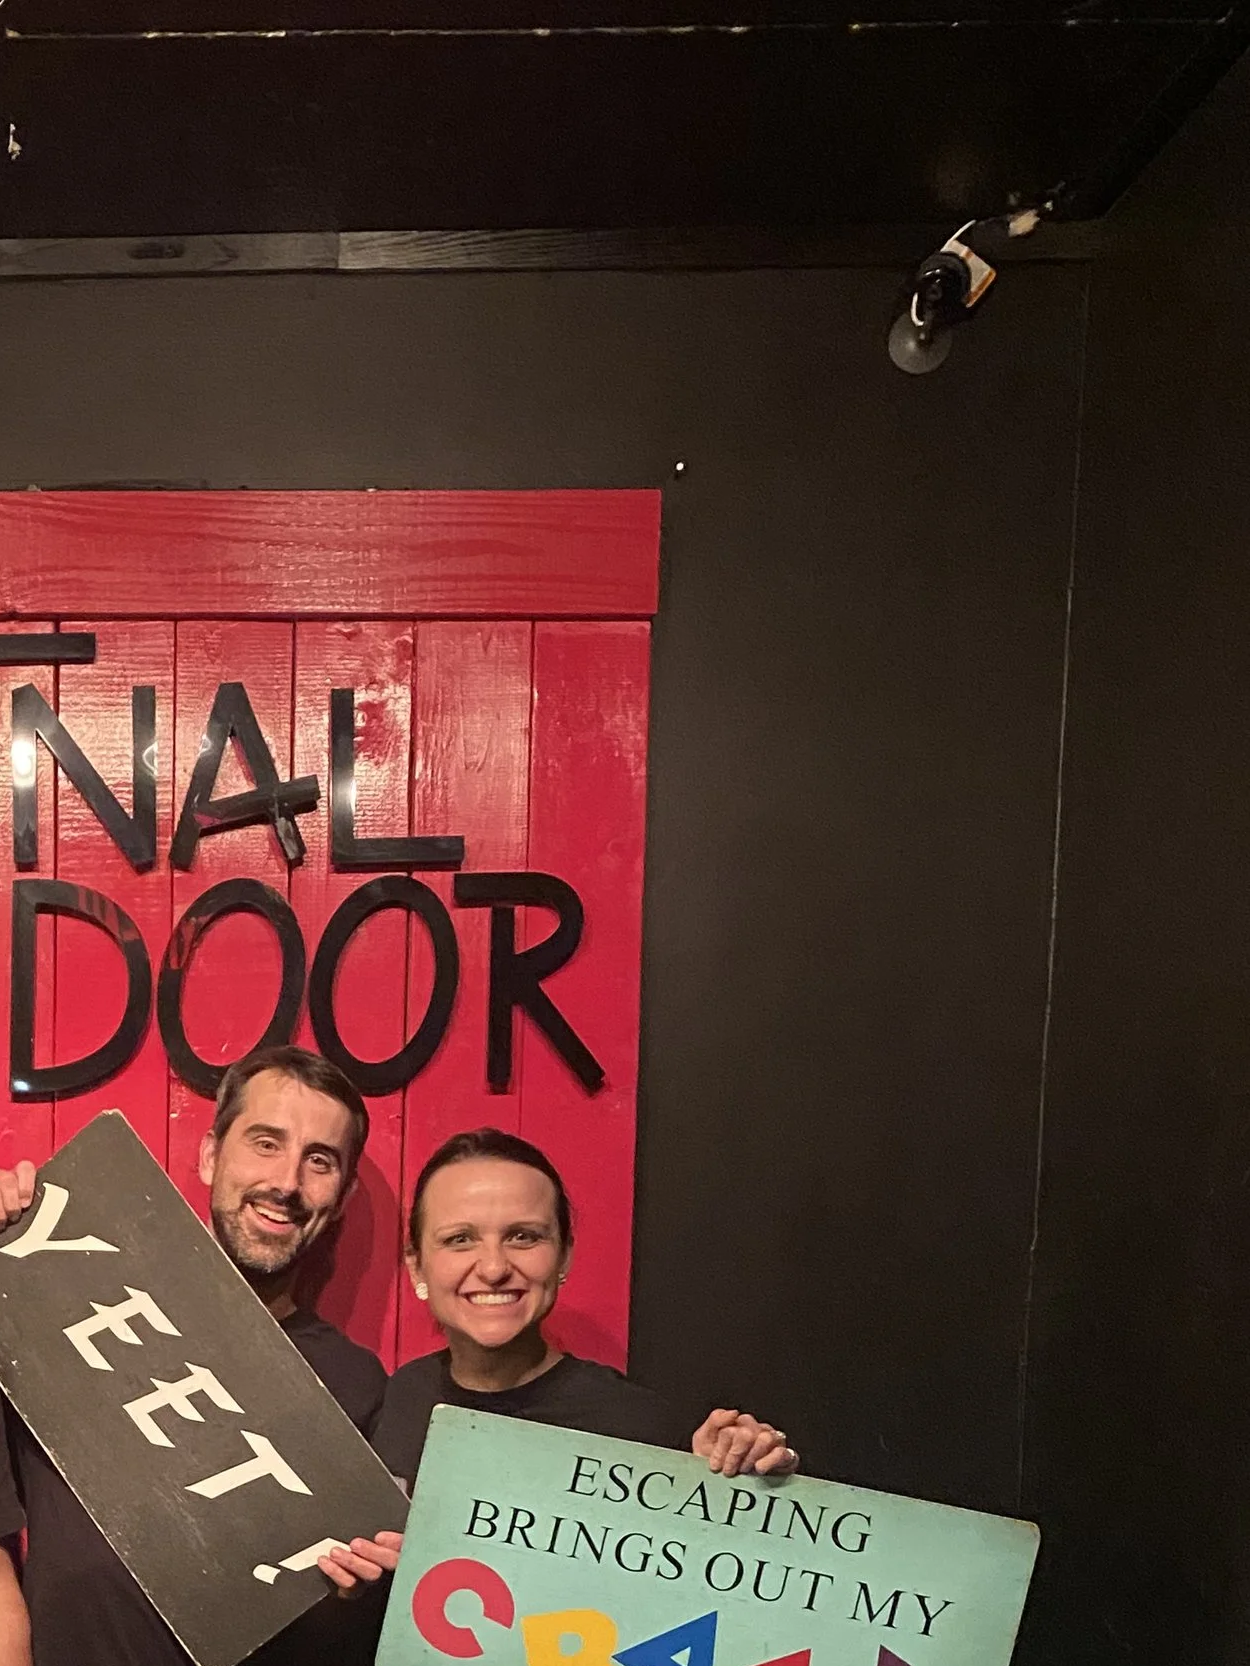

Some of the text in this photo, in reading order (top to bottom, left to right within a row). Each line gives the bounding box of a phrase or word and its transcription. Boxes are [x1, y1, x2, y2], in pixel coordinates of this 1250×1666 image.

[10, 871, 607, 1104] DOOR
[463, 1498, 955, 1638] BRINGS OUT MY
[566, 1454, 873, 1554] ESCAPING
